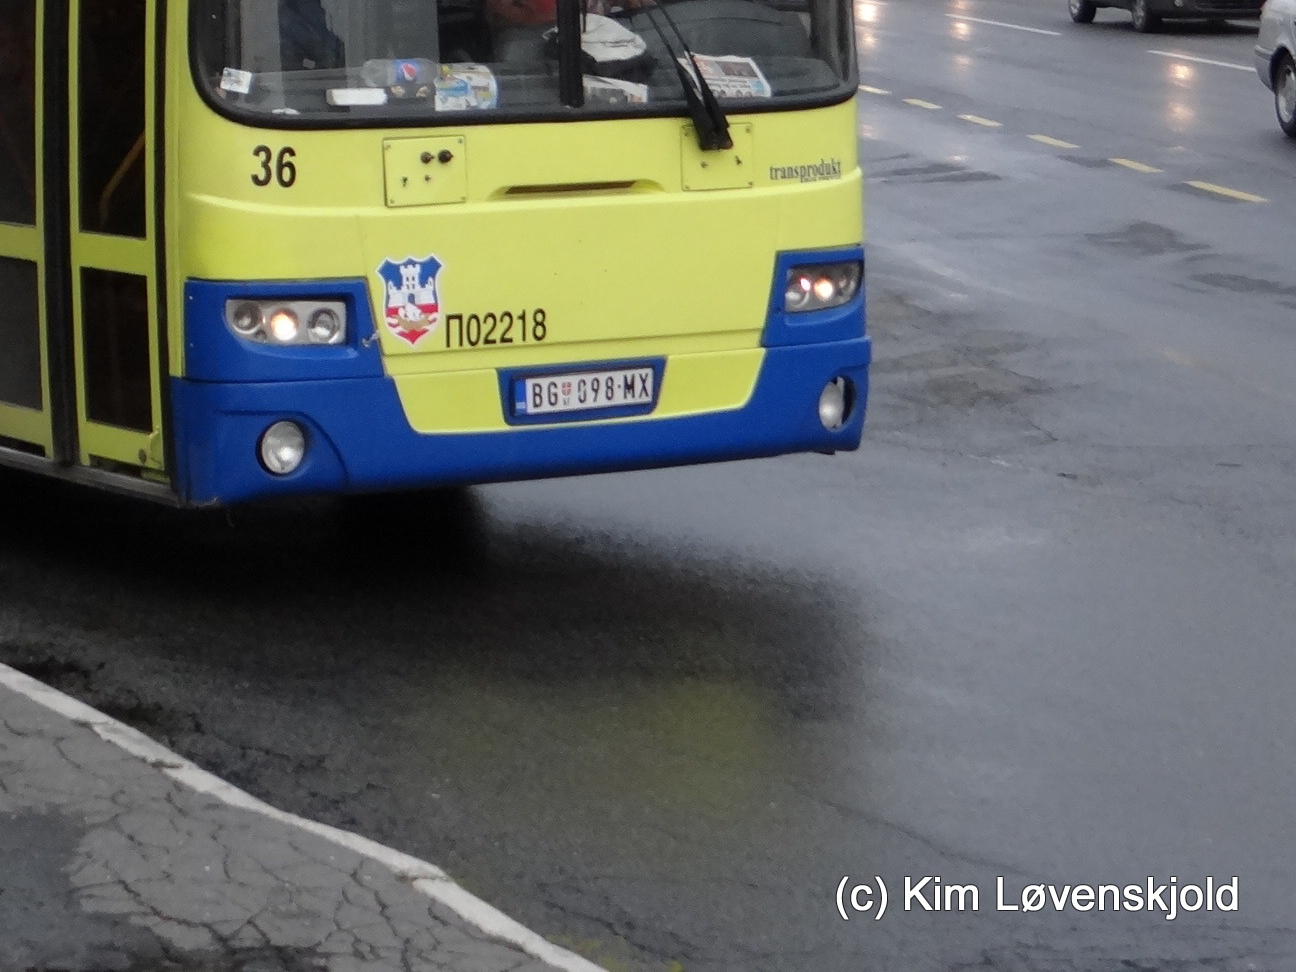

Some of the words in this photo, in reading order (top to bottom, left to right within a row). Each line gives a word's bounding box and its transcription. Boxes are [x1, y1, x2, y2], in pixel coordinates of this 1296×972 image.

[251, 144, 297, 188] 36
[769, 157, 841, 183] transprodukt
[532, 381, 558, 408] BG
